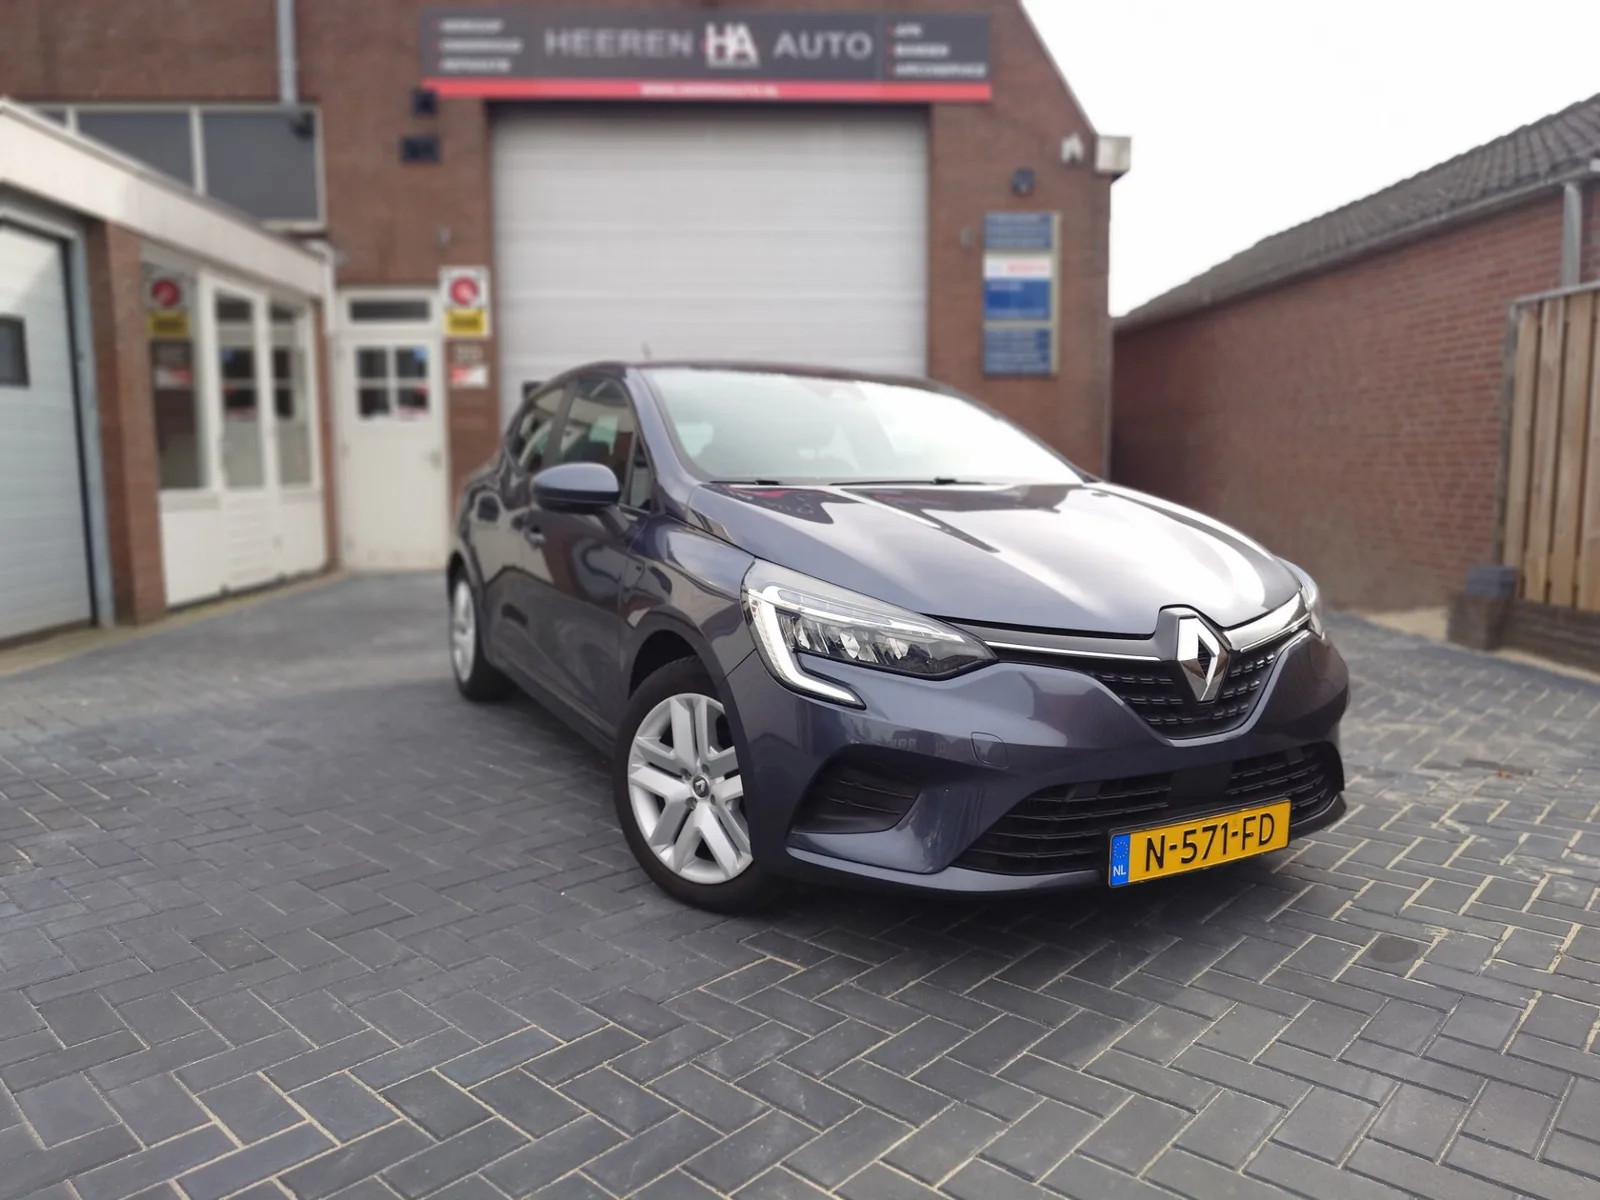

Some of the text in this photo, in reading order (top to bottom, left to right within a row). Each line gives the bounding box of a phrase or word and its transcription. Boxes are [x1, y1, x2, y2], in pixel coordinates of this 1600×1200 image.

[545, 29, 692, 59] HEEREN
[706, 22, 759, 63] HA
[773, 30, 874, 60] AUTO
[1145, 812, 1275, 872] N-571-FD
[1112, 864, 1127, 877] NL
